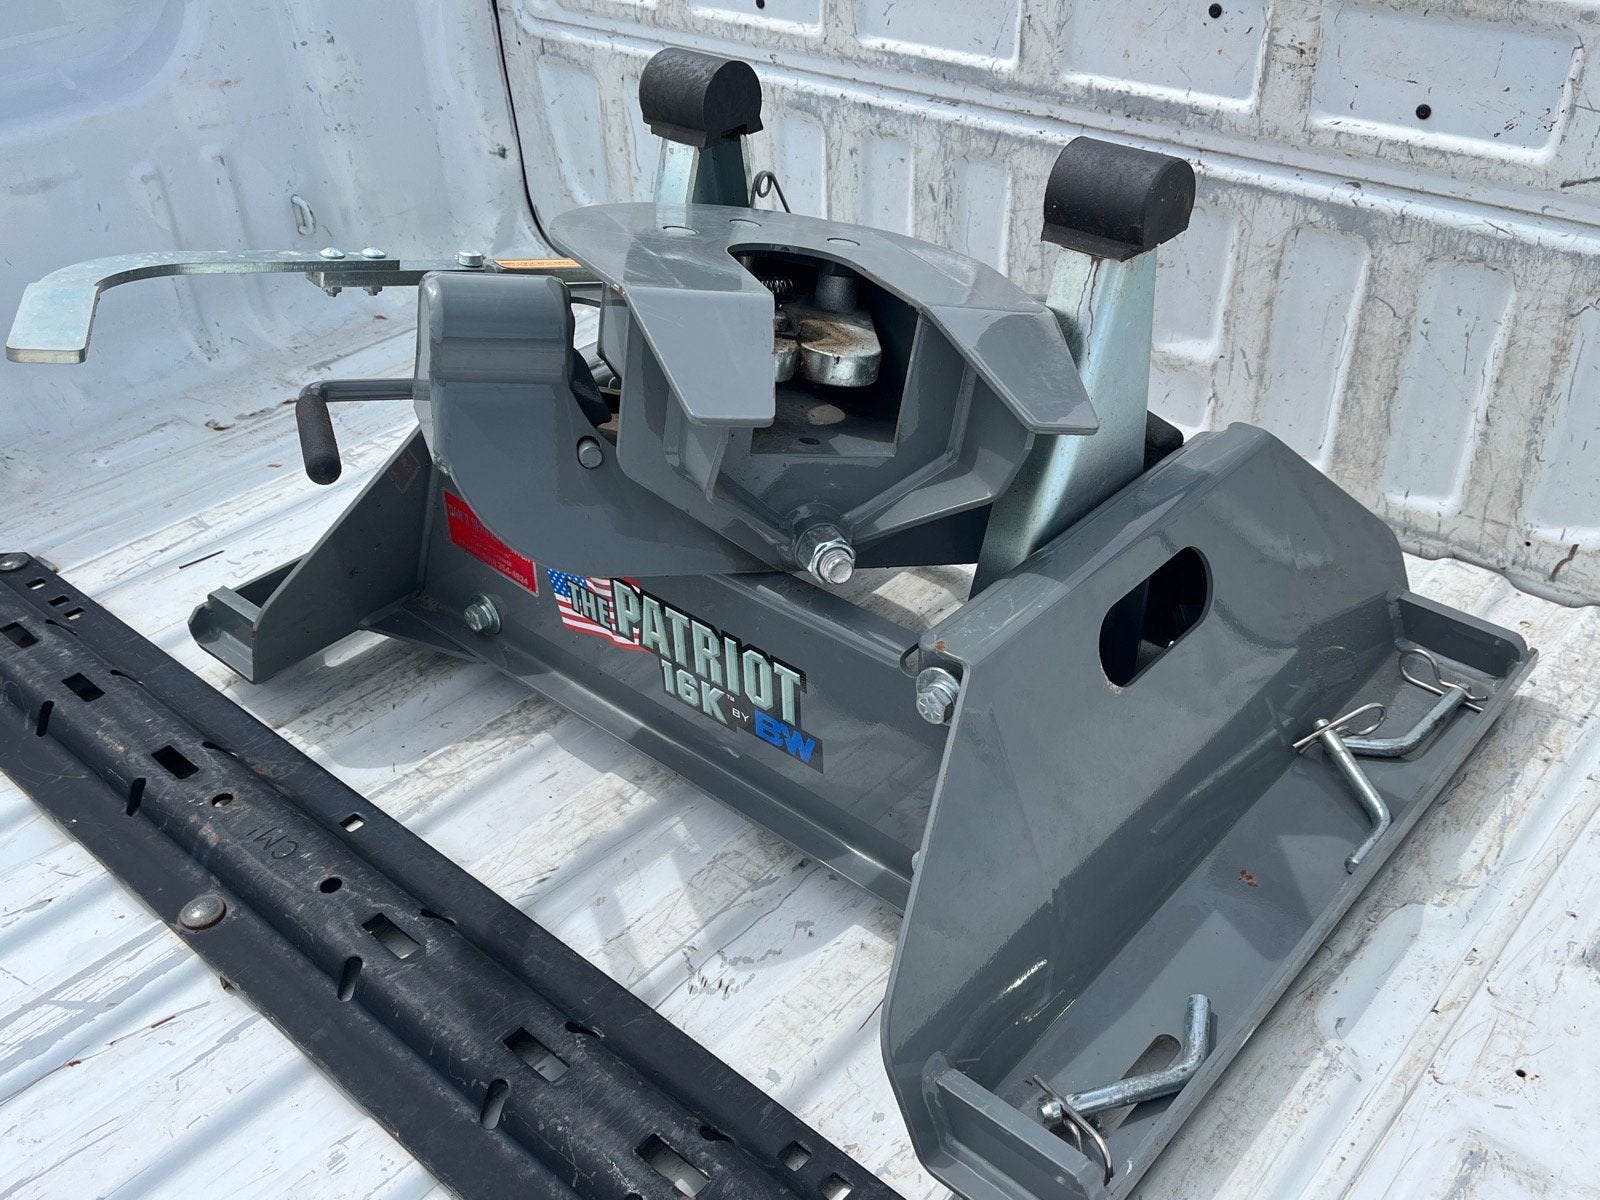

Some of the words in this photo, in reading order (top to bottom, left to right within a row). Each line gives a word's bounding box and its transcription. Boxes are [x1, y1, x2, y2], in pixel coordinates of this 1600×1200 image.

[566, 580, 612, 629] THE
[612, 579, 801, 727] PATRIOT
[661, 658, 728, 725] 16K
[731, 707, 750, 723] BY
